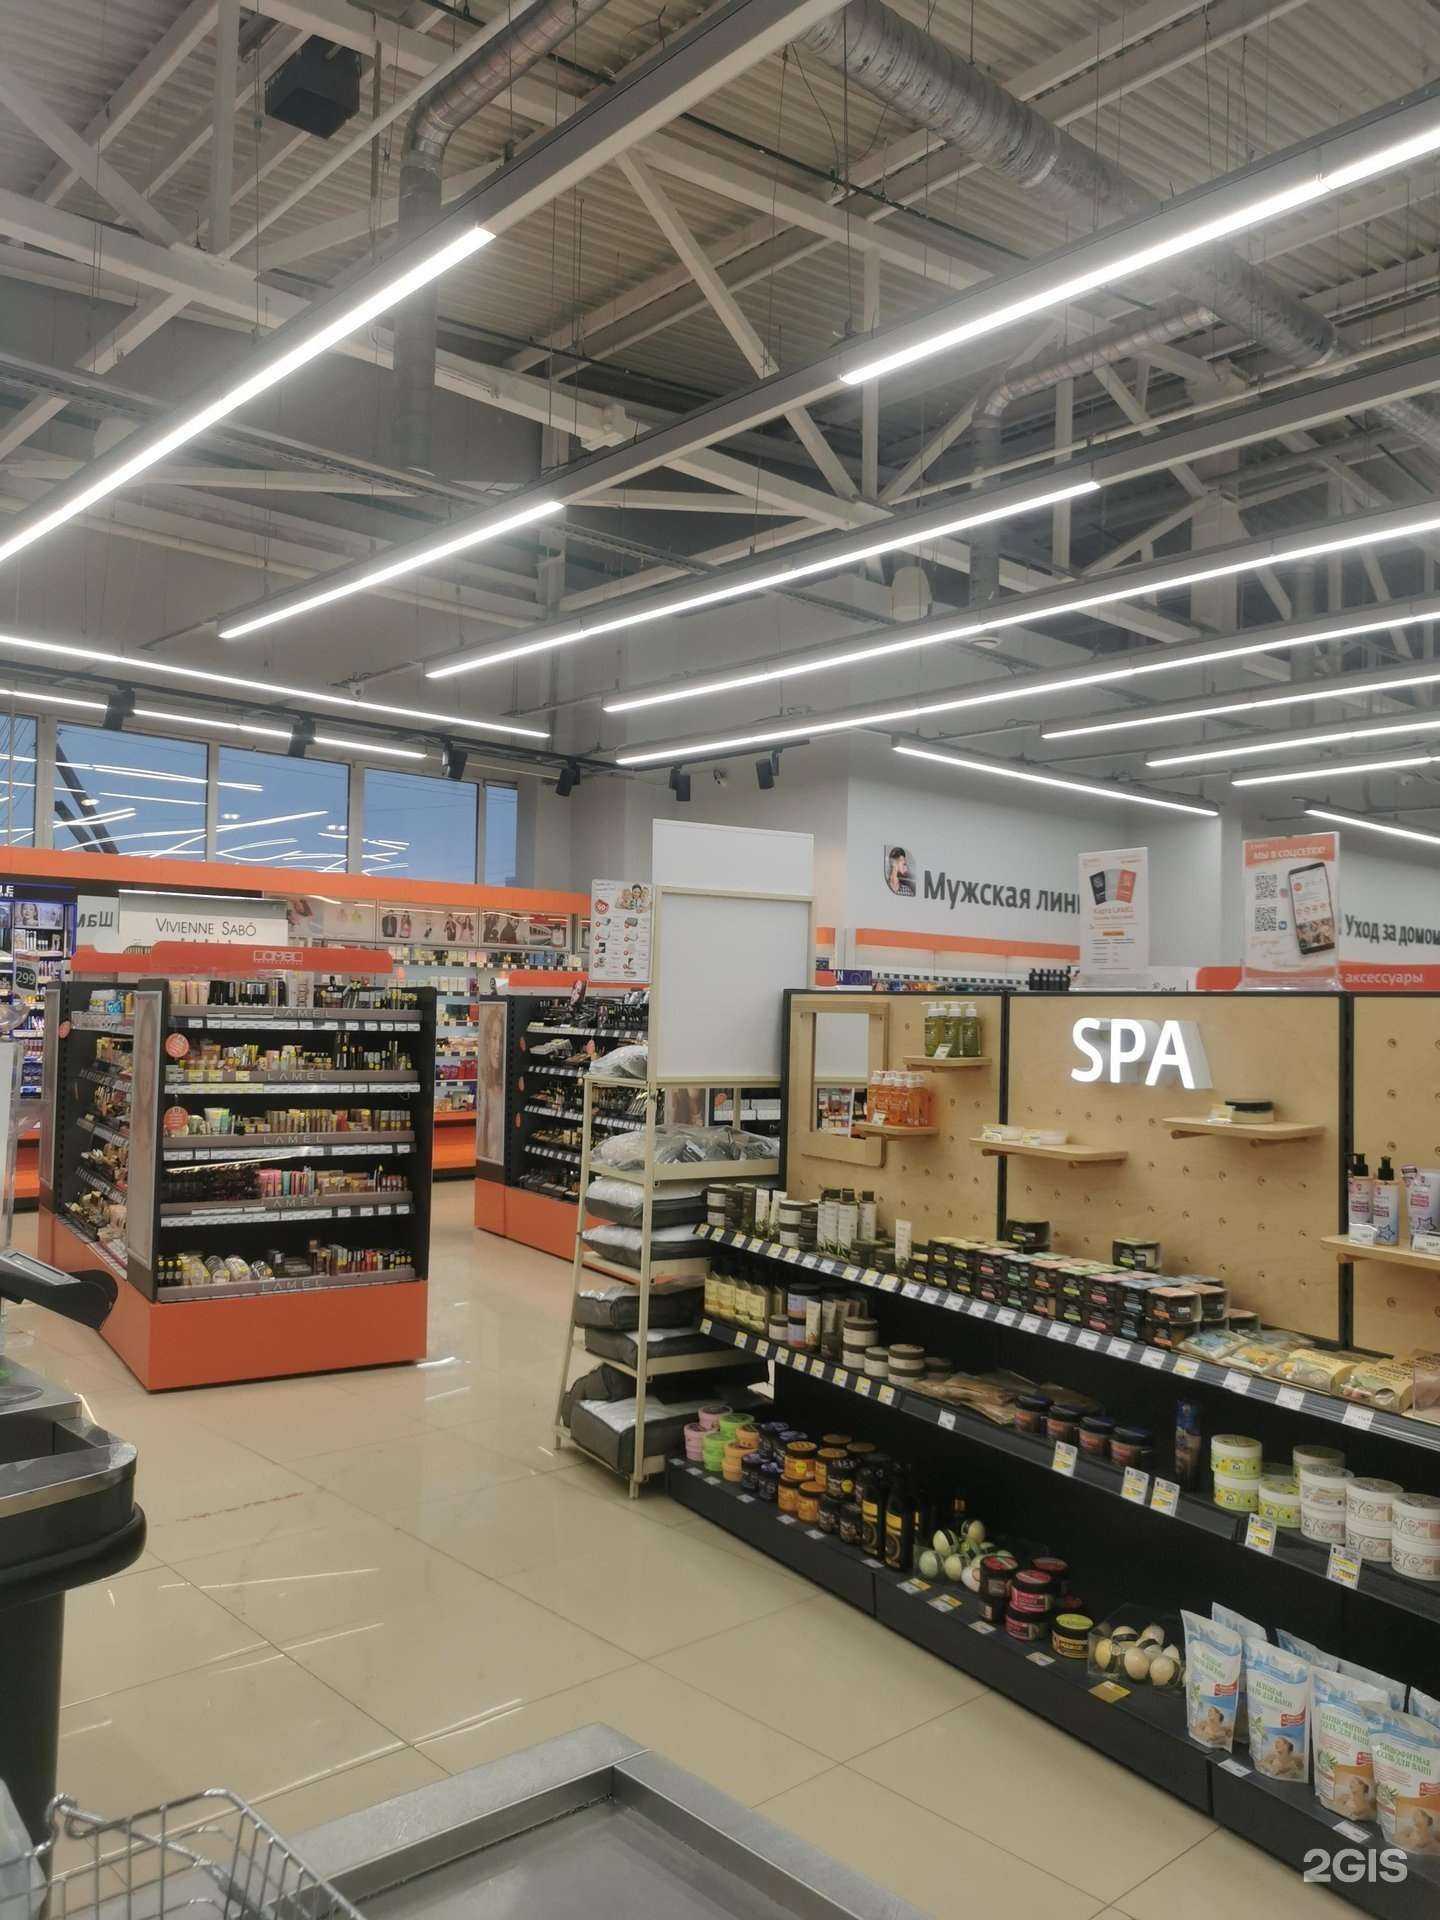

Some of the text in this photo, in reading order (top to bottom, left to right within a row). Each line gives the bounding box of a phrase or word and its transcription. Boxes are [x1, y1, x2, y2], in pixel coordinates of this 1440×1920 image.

[923, 870, 1031, 910] Мужская
[1345, 914, 1380, 944] Уход
[1382, 923, 1397, 941] за
[16, 971, 36, 986] 299
[1345, 973, 1424, 986] аксессуары
[273, 1008, 332, 1018] LAMEL
[1070, 1017, 1196, 1090] SPA
[267, 1070, 328, 1081] LAMEL
[263, 1134, 323, 1144] LAMEL
[261, 1279, 323, 1291] LAMEL
